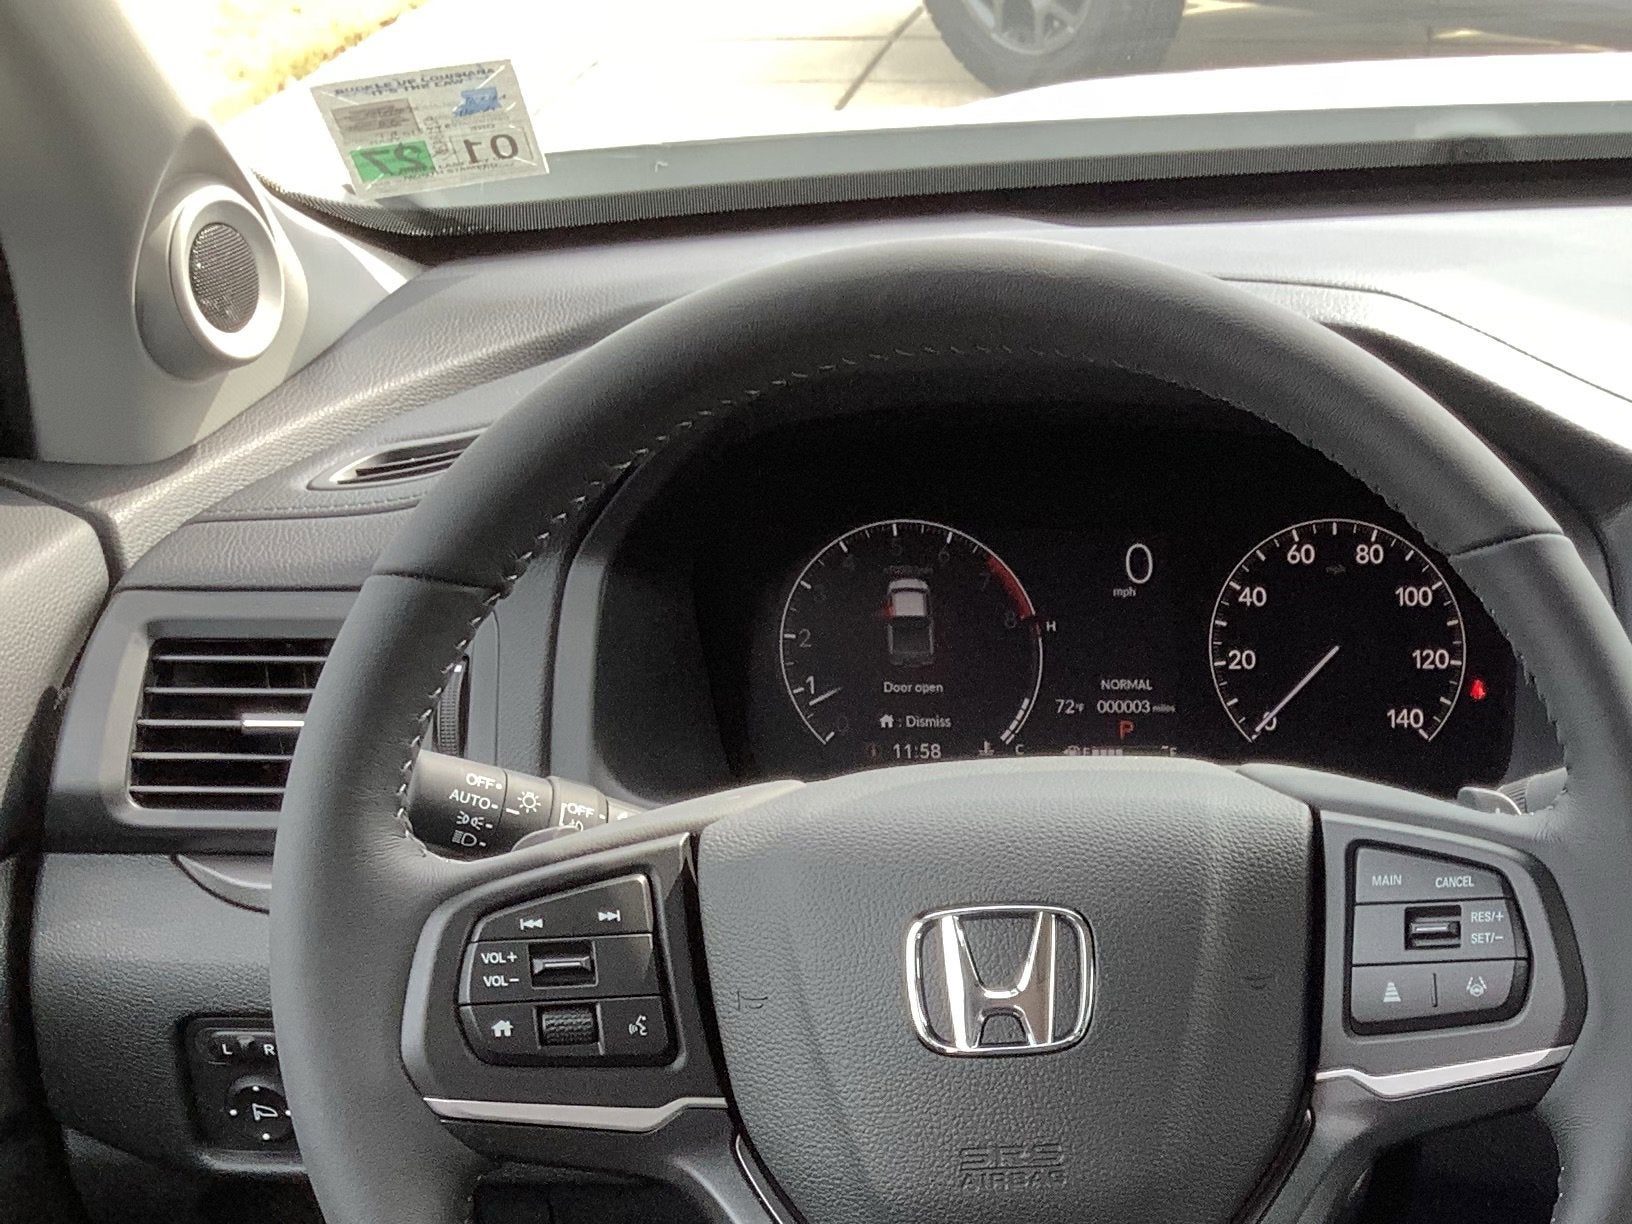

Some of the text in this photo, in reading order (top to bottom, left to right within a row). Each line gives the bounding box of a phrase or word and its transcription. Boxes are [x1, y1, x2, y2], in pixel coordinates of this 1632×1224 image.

[396, 78, 417, 88] UP
[1286, 544, 1316, 566] 60
[1356, 544, 1384, 566] 80
[1125, 543, 1153, 584] 0
[1113, 586, 1136, 598] mph
[1238, 586, 1267, 607] 40
[1395, 586, 1433, 607] 100
[1046, 621, 1057, 633] H
[799, 629, 813, 648] 2
[1228, 650, 1256, 670] 20
[1412, 649, 1450, 669] 120
[805, 676, 816, 695] 1
[883, 682, 944, 697] Door open
[1101, 679, 1152, 691] NORMAL
[1096, 699, 1150, 714] 000003
[906, 715, 951, 728] Dismiss
[1386, 708, 1424, 730] 140
[1119, 719, 1135, 739] P
[893, 744, 941, 759] 11:58
[466, 773, 496, 790] OFF
[449, 789, 492, 809] AUTO
[567, 803, 595, 818] OFF
[1372, 875, 1474, 888] MAIN CANCEL
[1471, 911, 1504, 923] RES/+
[480, 951, 518, 964] VOL+
[222, 1043, 276, 1056] L R
